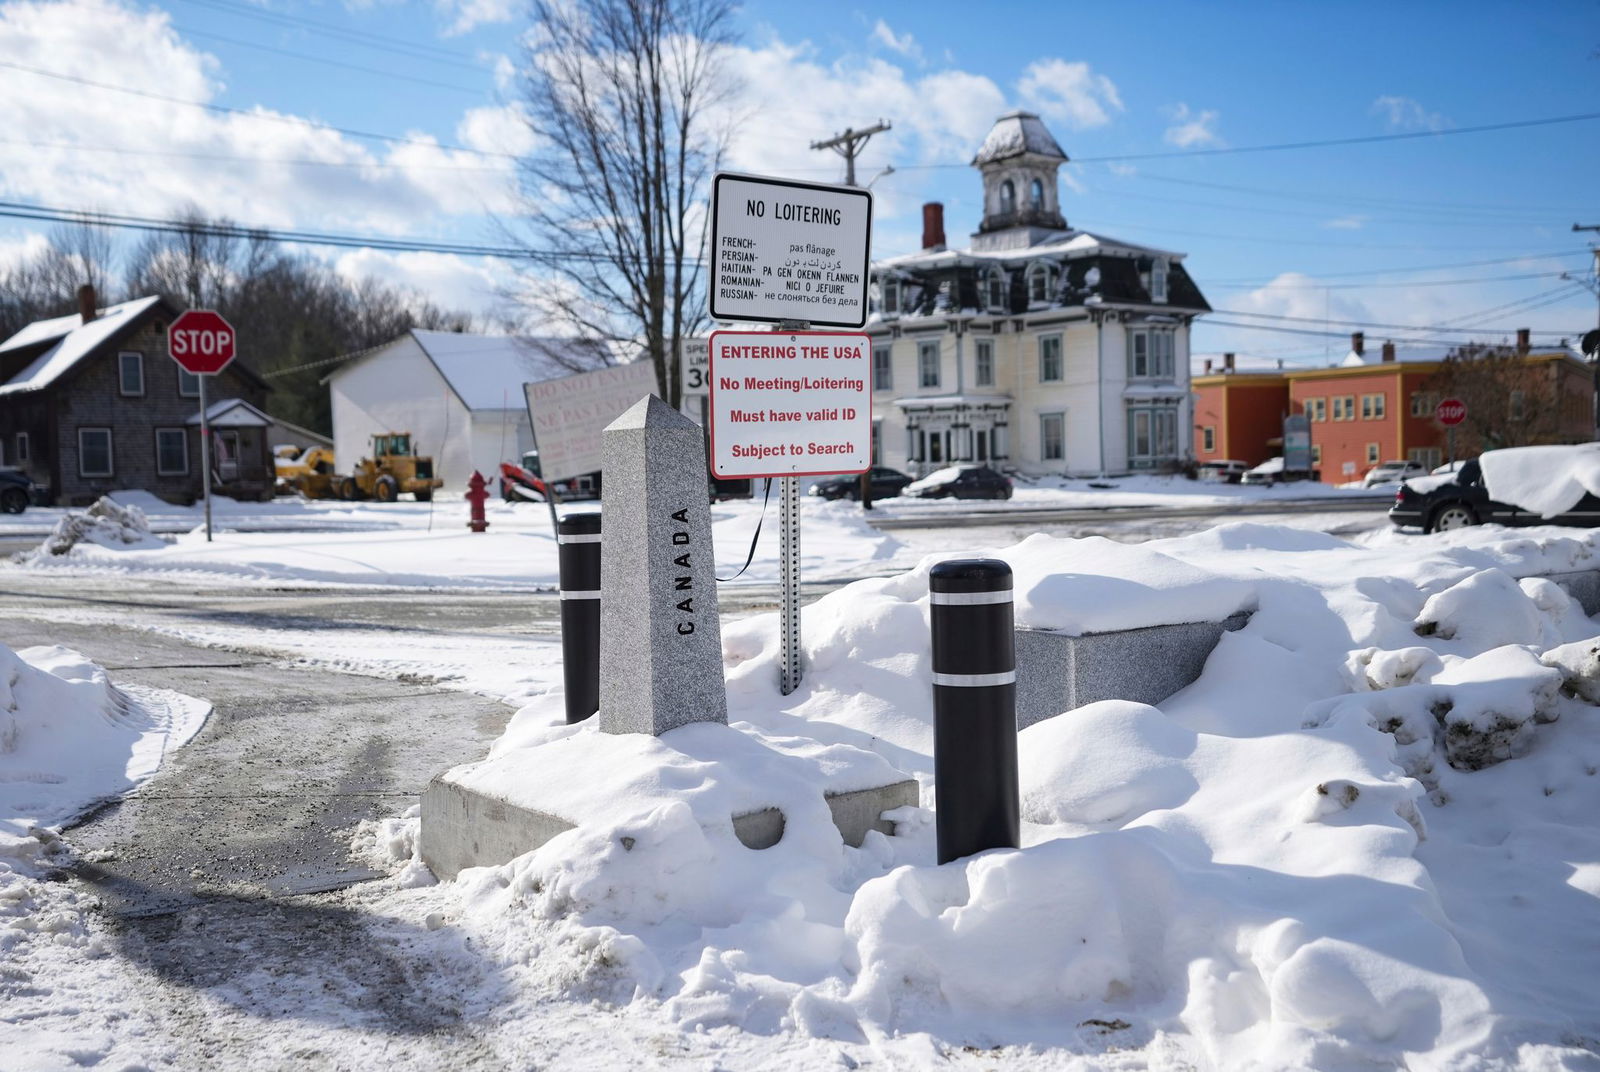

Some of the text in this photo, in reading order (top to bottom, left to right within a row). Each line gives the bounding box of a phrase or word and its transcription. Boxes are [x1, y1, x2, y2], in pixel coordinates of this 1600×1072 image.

[746, 199, 841, 226] NO LOITERING
[722, 236, 836, 257] FRENCH- pas flânage
[721, 250, 758, 262] PERSIAN-
[721, 262, 860, 284] HAITIAN- PA GEN OKENN FLANNEN
[721, 275, 764, 288] ROMANIAN-
[786, 280, 800, 291] NICI
[816, 284, 845, 295] JEFUIRE
[720, 288, 758, 300] RUSSIAN-
[778, 293, 820, 304] слоняться
[822, 295, 836, 304] без
[838, 298, 858, 308] дела
[174, 330, 230, 355] STOP
[686, 344, 708, 354] SPE
[721, 346, 862, 359] ENTERING THE USA
[690, 357, 708, 366] LIM
[533, 382, 556, 399] DO
[562, 374, 592, 392] NOT
[688, 368, 709, 388] 3
[720, 376, 864, 392] No Meeting/Loitering
[730, 408, 856, 422] Must have valid ID
[1438, 405, 1464, 418] STOP
[732, 442, 854, 460] Subject to Search
[672, 508, 694, 636] CANADA
